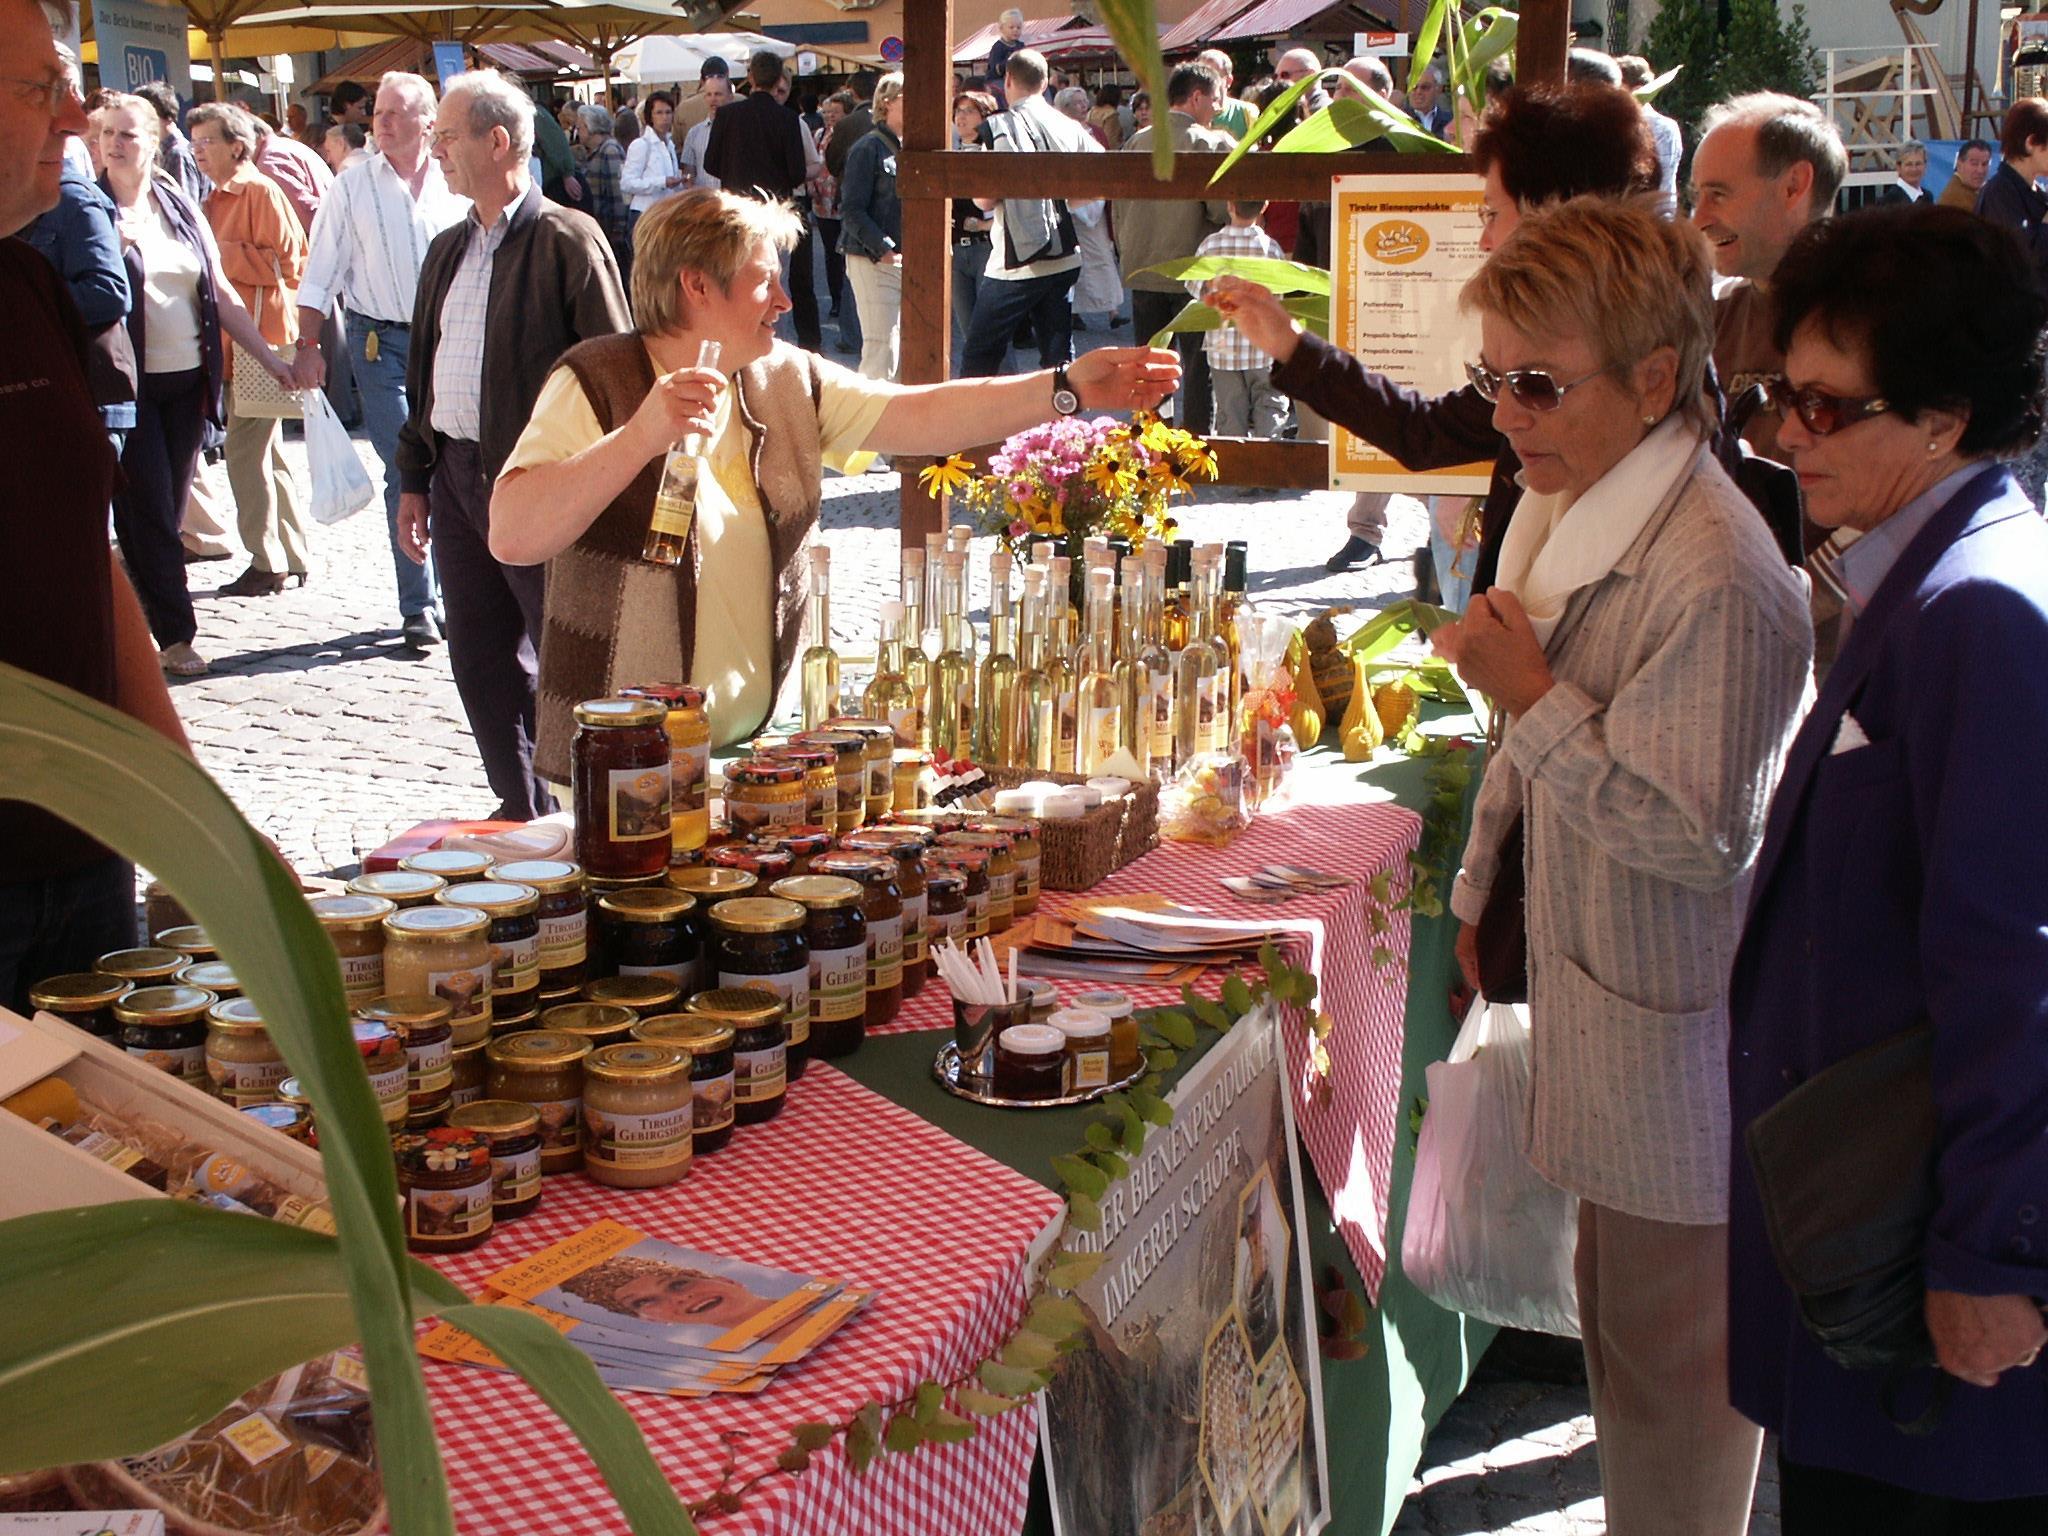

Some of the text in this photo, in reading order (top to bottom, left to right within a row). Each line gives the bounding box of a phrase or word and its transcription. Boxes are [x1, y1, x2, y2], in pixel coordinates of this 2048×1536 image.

[113, 13, 130, 28] Beste
[131, 17, 153, 32] kommt
[154, 23, 167, 33] vom
[127, 52, 155, 85] BIO
[1349, 204, 1378, 213] Tiroler
[638, 1113, 684, 1130] TIROLER
[1102, 1125, 1241, 1328] IMKEREI SCHÖPF
